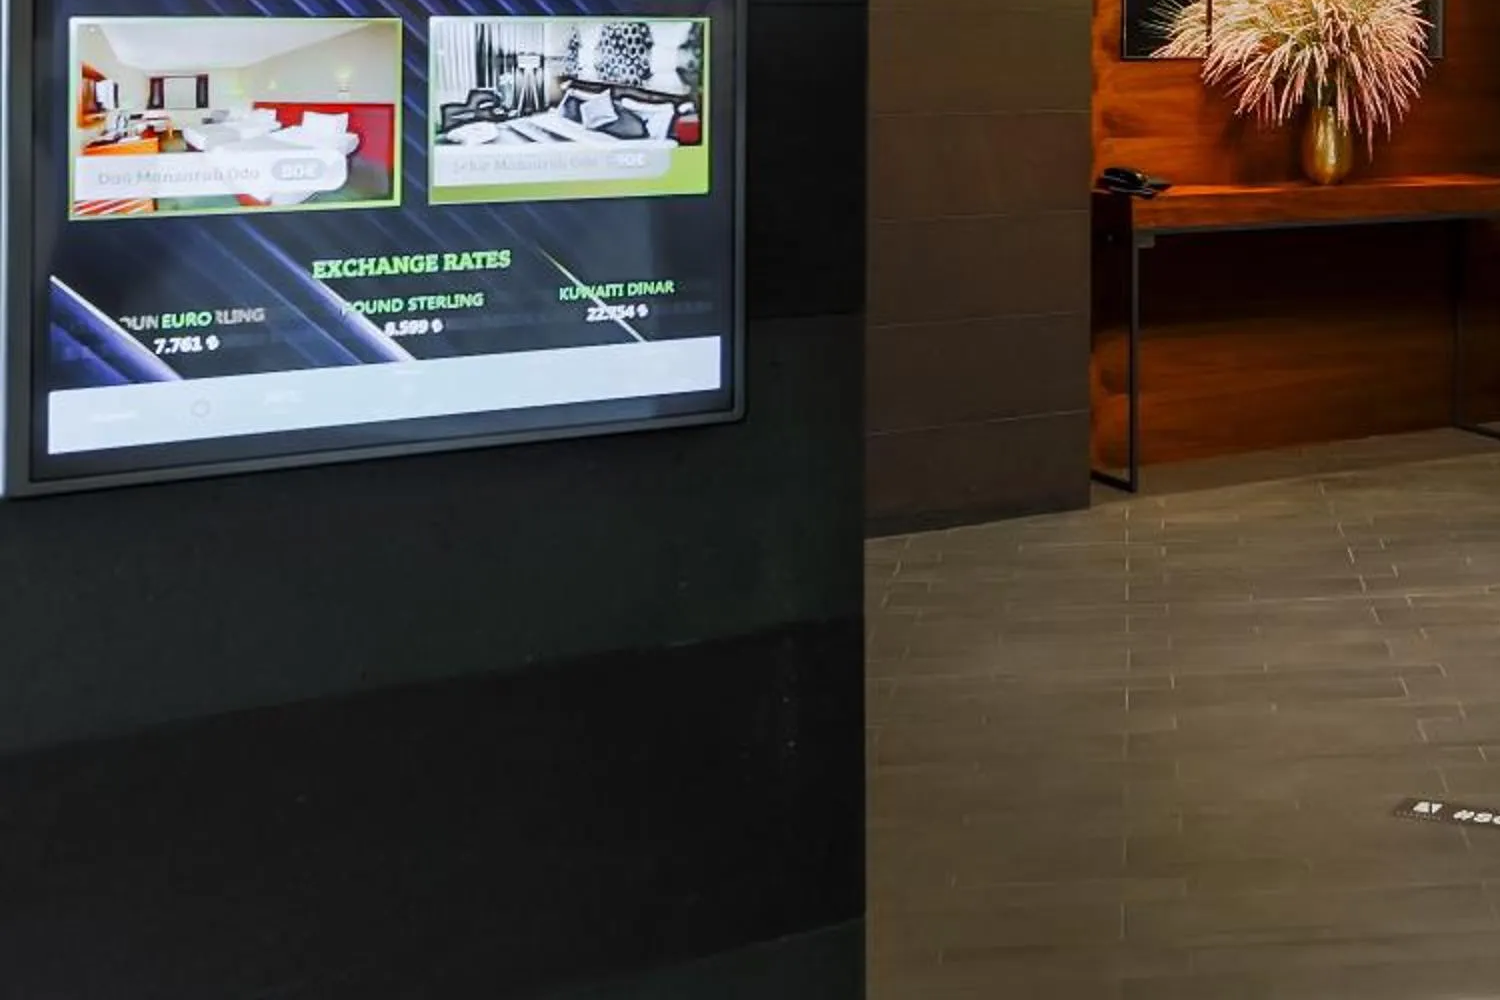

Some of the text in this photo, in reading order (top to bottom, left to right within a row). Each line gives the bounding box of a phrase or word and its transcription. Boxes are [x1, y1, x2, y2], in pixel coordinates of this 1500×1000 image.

[311, 250, 511, 280] EXCHANGE RATES
[559, 280, 675, 301] KUWAITI DINAR
[407, 293, 484, 312] STERLING
[161, 310, 213, 329] EURO
